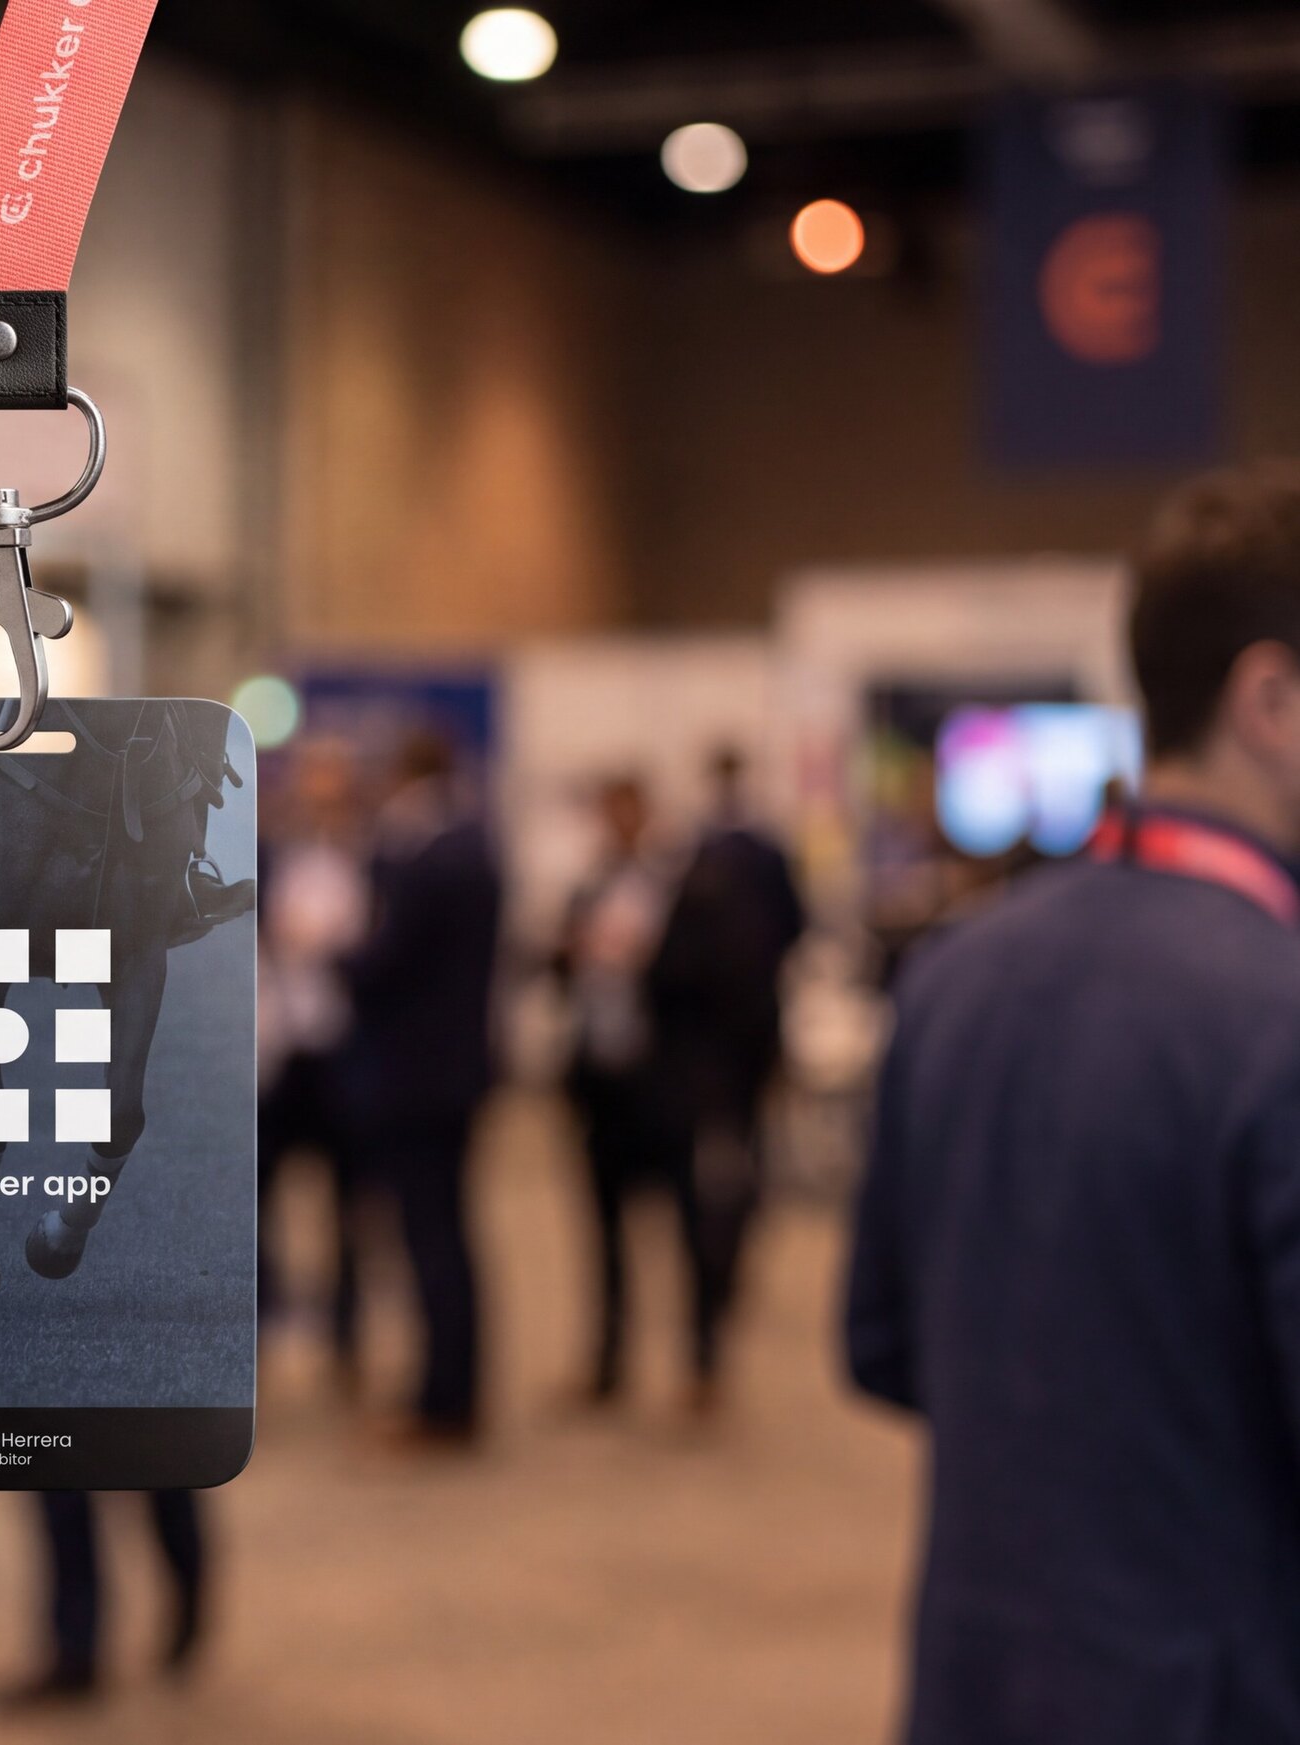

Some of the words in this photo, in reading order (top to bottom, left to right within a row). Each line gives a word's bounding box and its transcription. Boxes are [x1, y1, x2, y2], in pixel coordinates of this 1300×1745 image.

[18, 15, 86, 183] chukker
[43, 1175, 111, 1204] app
[1, 1432, 72, 1448] Herrera
